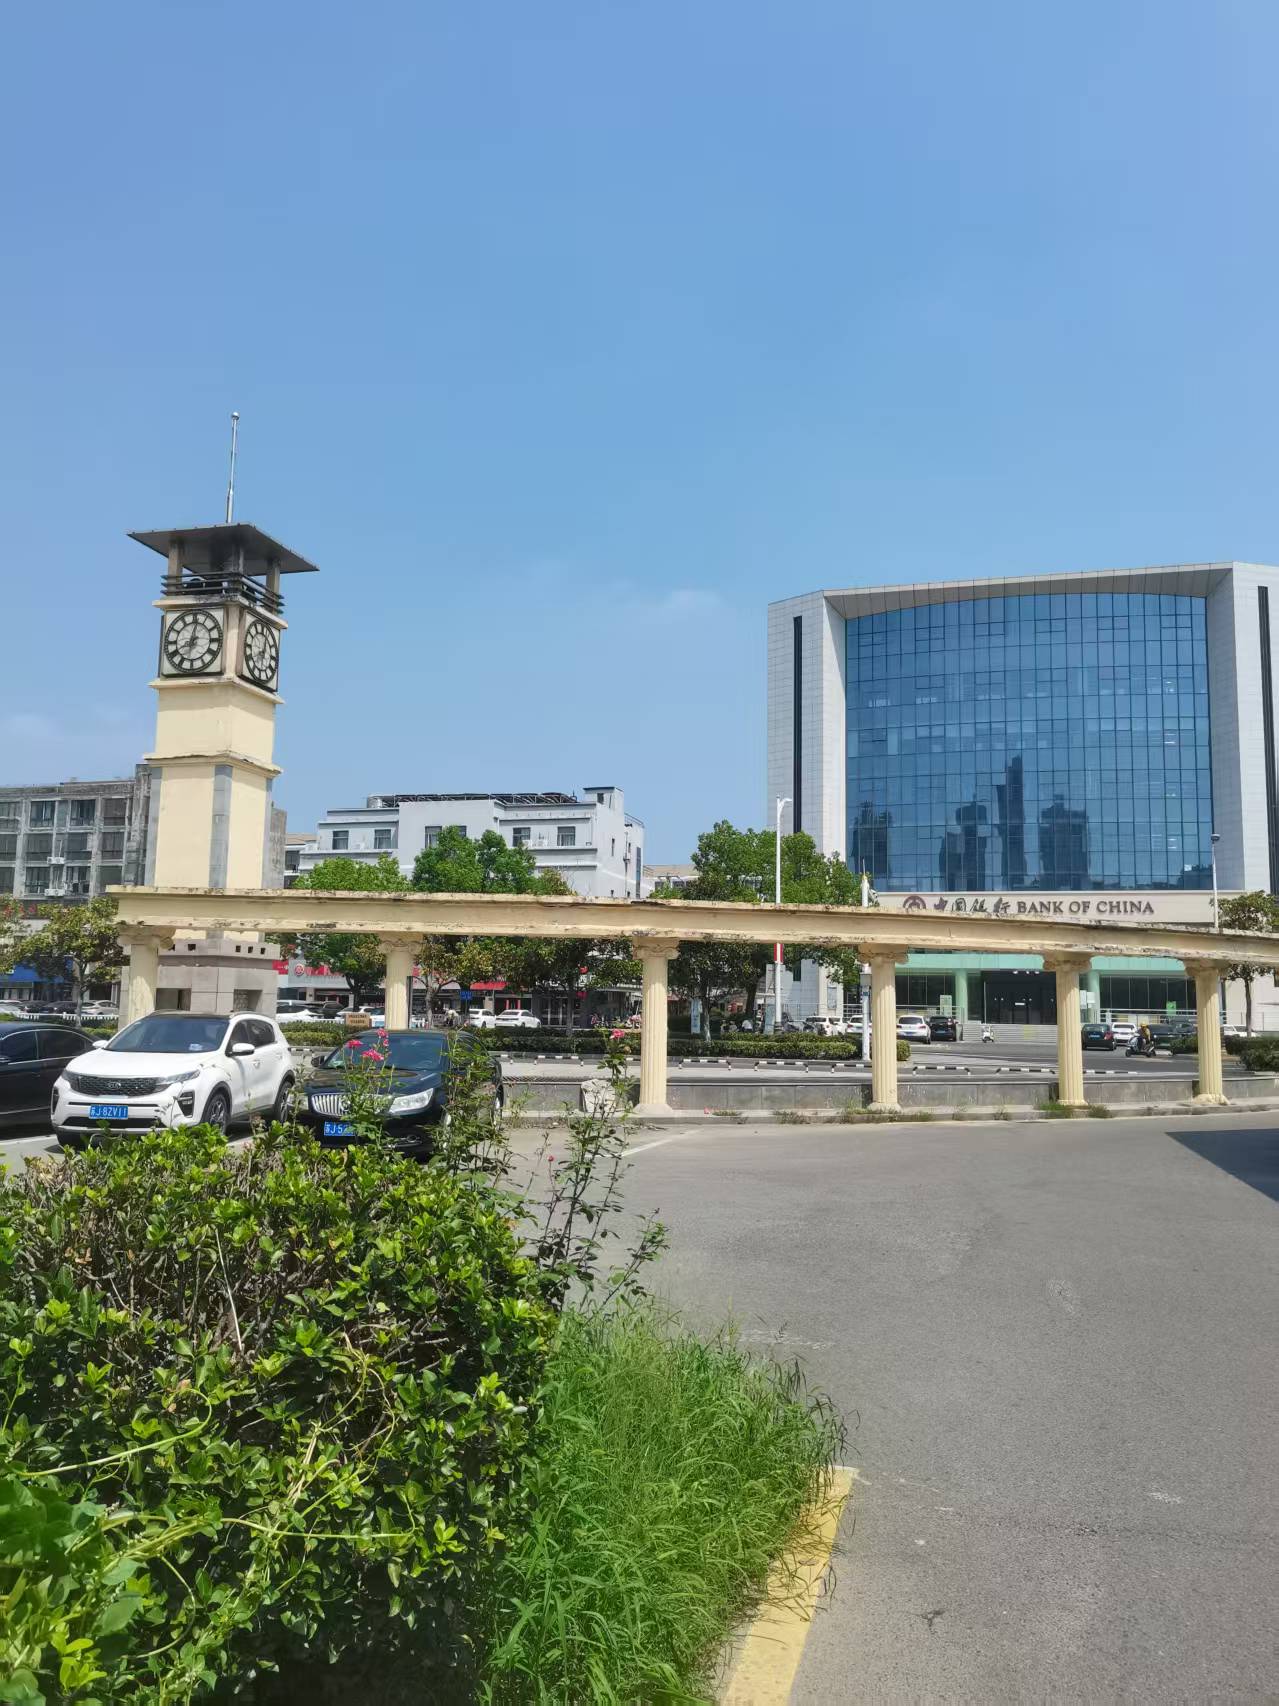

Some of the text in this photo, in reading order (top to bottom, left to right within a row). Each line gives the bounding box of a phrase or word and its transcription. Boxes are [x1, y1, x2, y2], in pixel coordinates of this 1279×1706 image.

[1017, 900, 1155, 915] BANK OF CHINA
